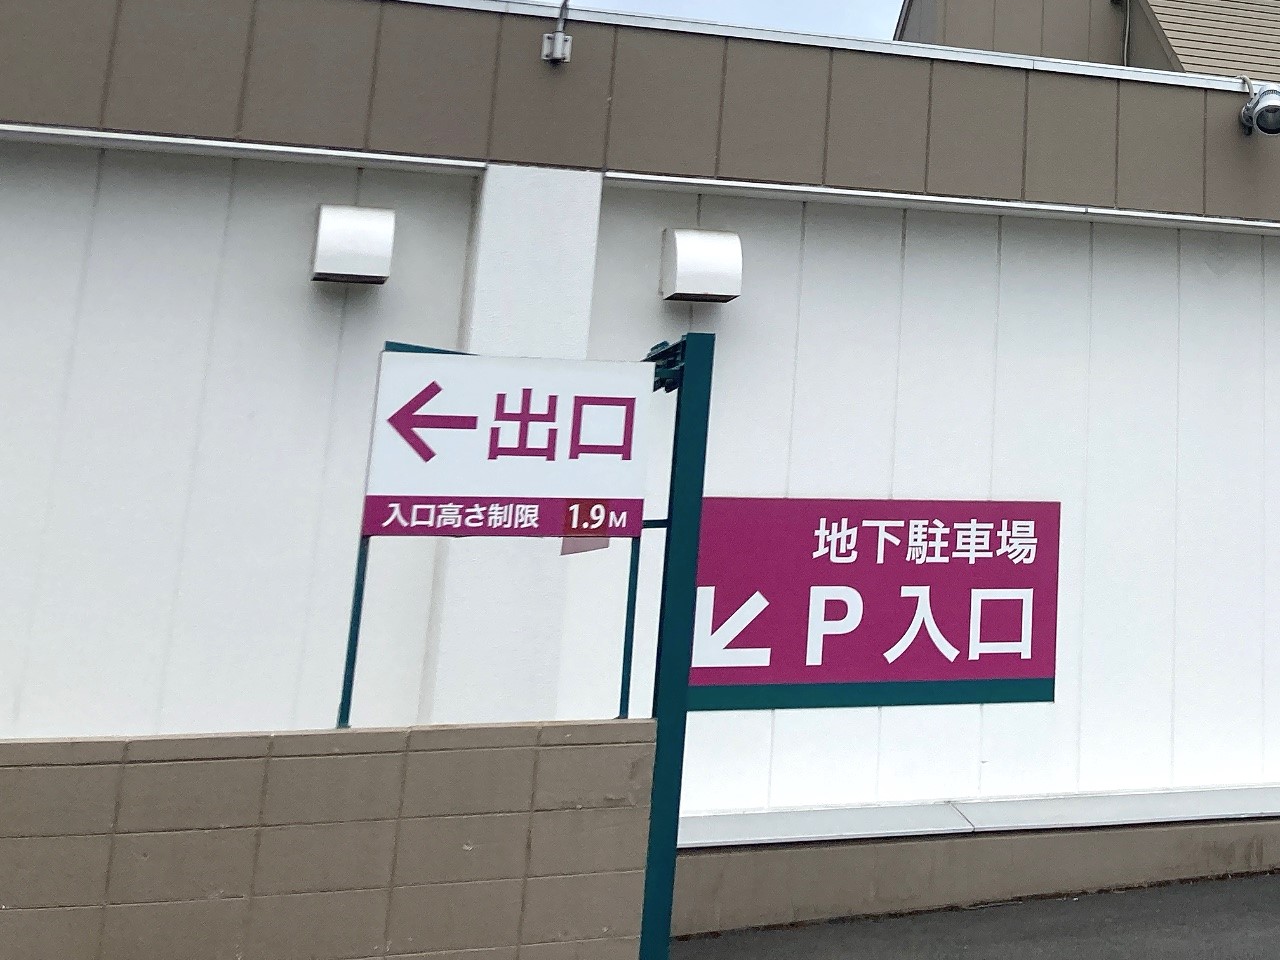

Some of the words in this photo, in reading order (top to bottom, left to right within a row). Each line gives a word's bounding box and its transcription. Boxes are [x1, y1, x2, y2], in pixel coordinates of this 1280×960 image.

[487, 387, 636, 462] 出口
[381, 502, 540, 529] 入口高さ制限
[567, 502, 628, 530] 1.9M
[812, 516, 1038, 566] 地下駐車場
[805, 584, 864, 667] P
[882, 584, 1035, 664] 入口
